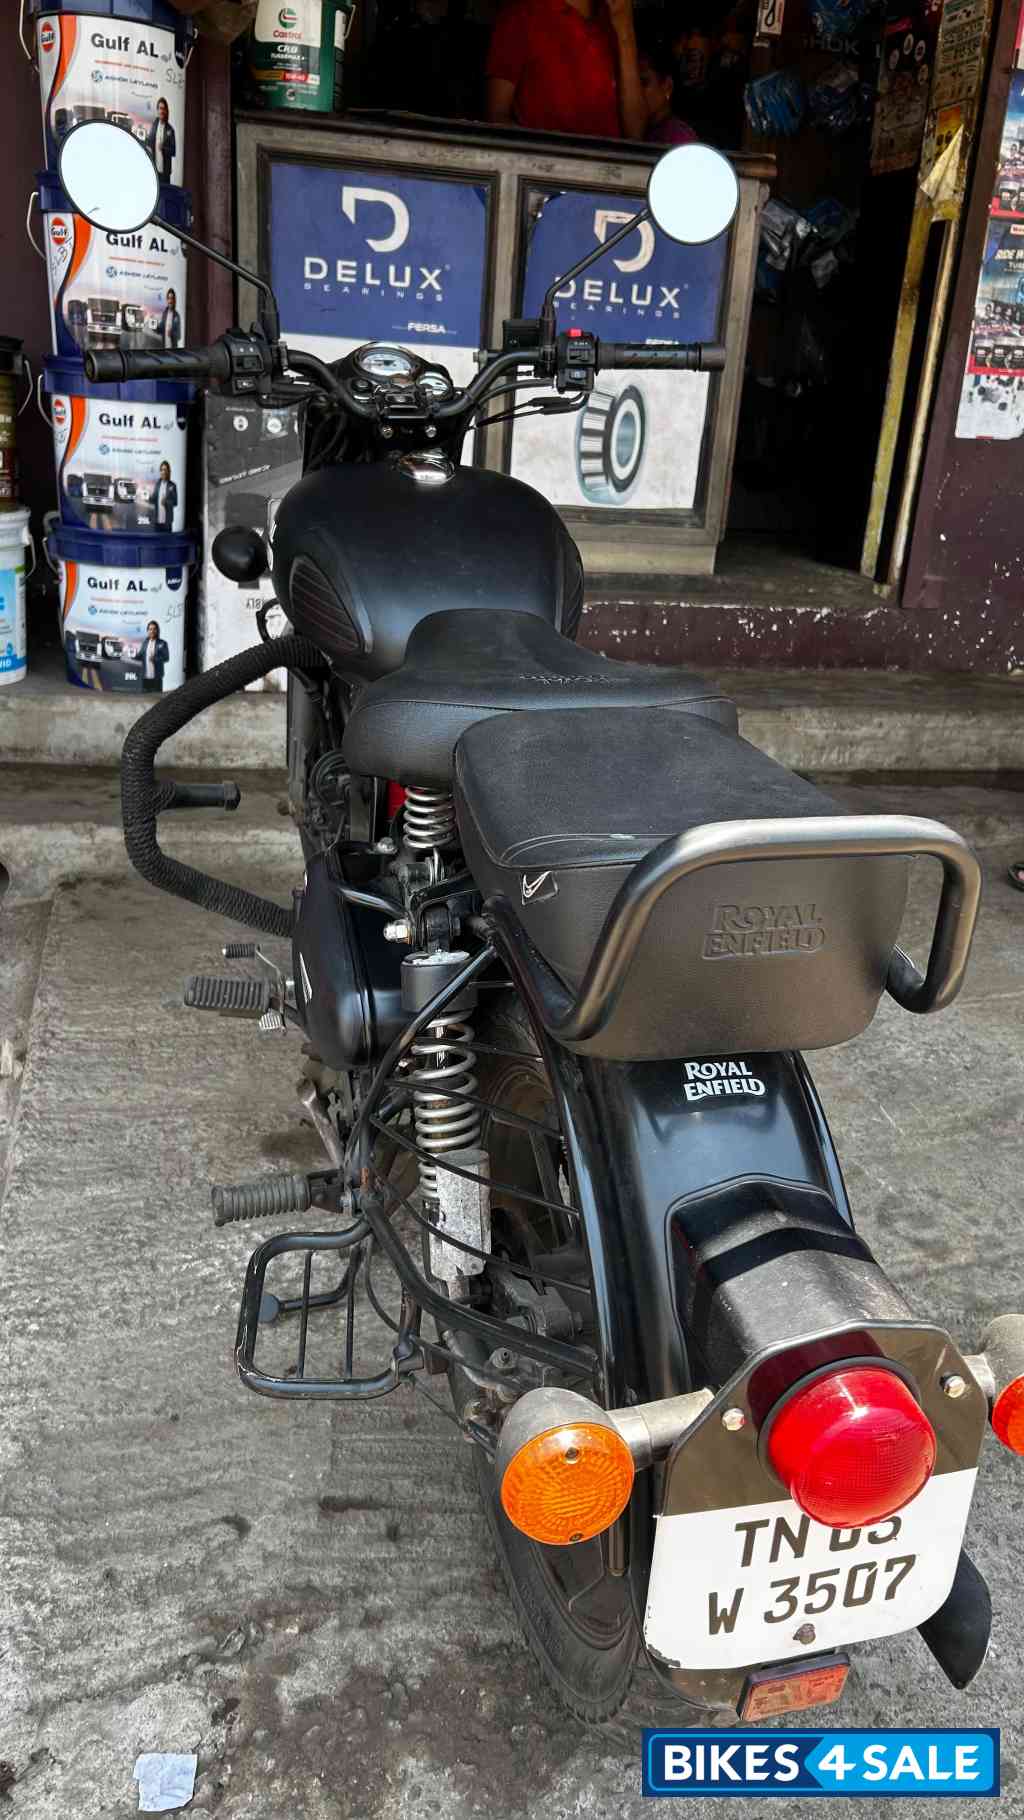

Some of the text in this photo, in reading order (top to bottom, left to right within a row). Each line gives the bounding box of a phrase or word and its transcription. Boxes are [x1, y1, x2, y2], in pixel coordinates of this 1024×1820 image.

[272, 30, 304, 39] Castrol
[91, 33, 130, 51] Gulf
[136, 41, 159, 58] AL
[106, 231, 168, 253] Gulf AL
[304, 257, 441, 290] DELUX
[304, 283, 442, 301] BEARINGS
[554, 276, 680, 309] DELUX
[553, 301, 680, 318] BEARINGS
[408, 322, 446, 334] FERSA
[99, 413, 161, 429] Gulf AL
[87, 577, 148, 592] Gulf AL
[712, 903, 822, 933] ROYAL
[702, 927, 826, 959] ENFIELD
[684, 1062, 752, 1080] ROYAL
[684, 1079, 765, 1100] ENFIELD
[735, 1513, 811, 1568] TN
[708, 1554, 917, 1635] W 3507
